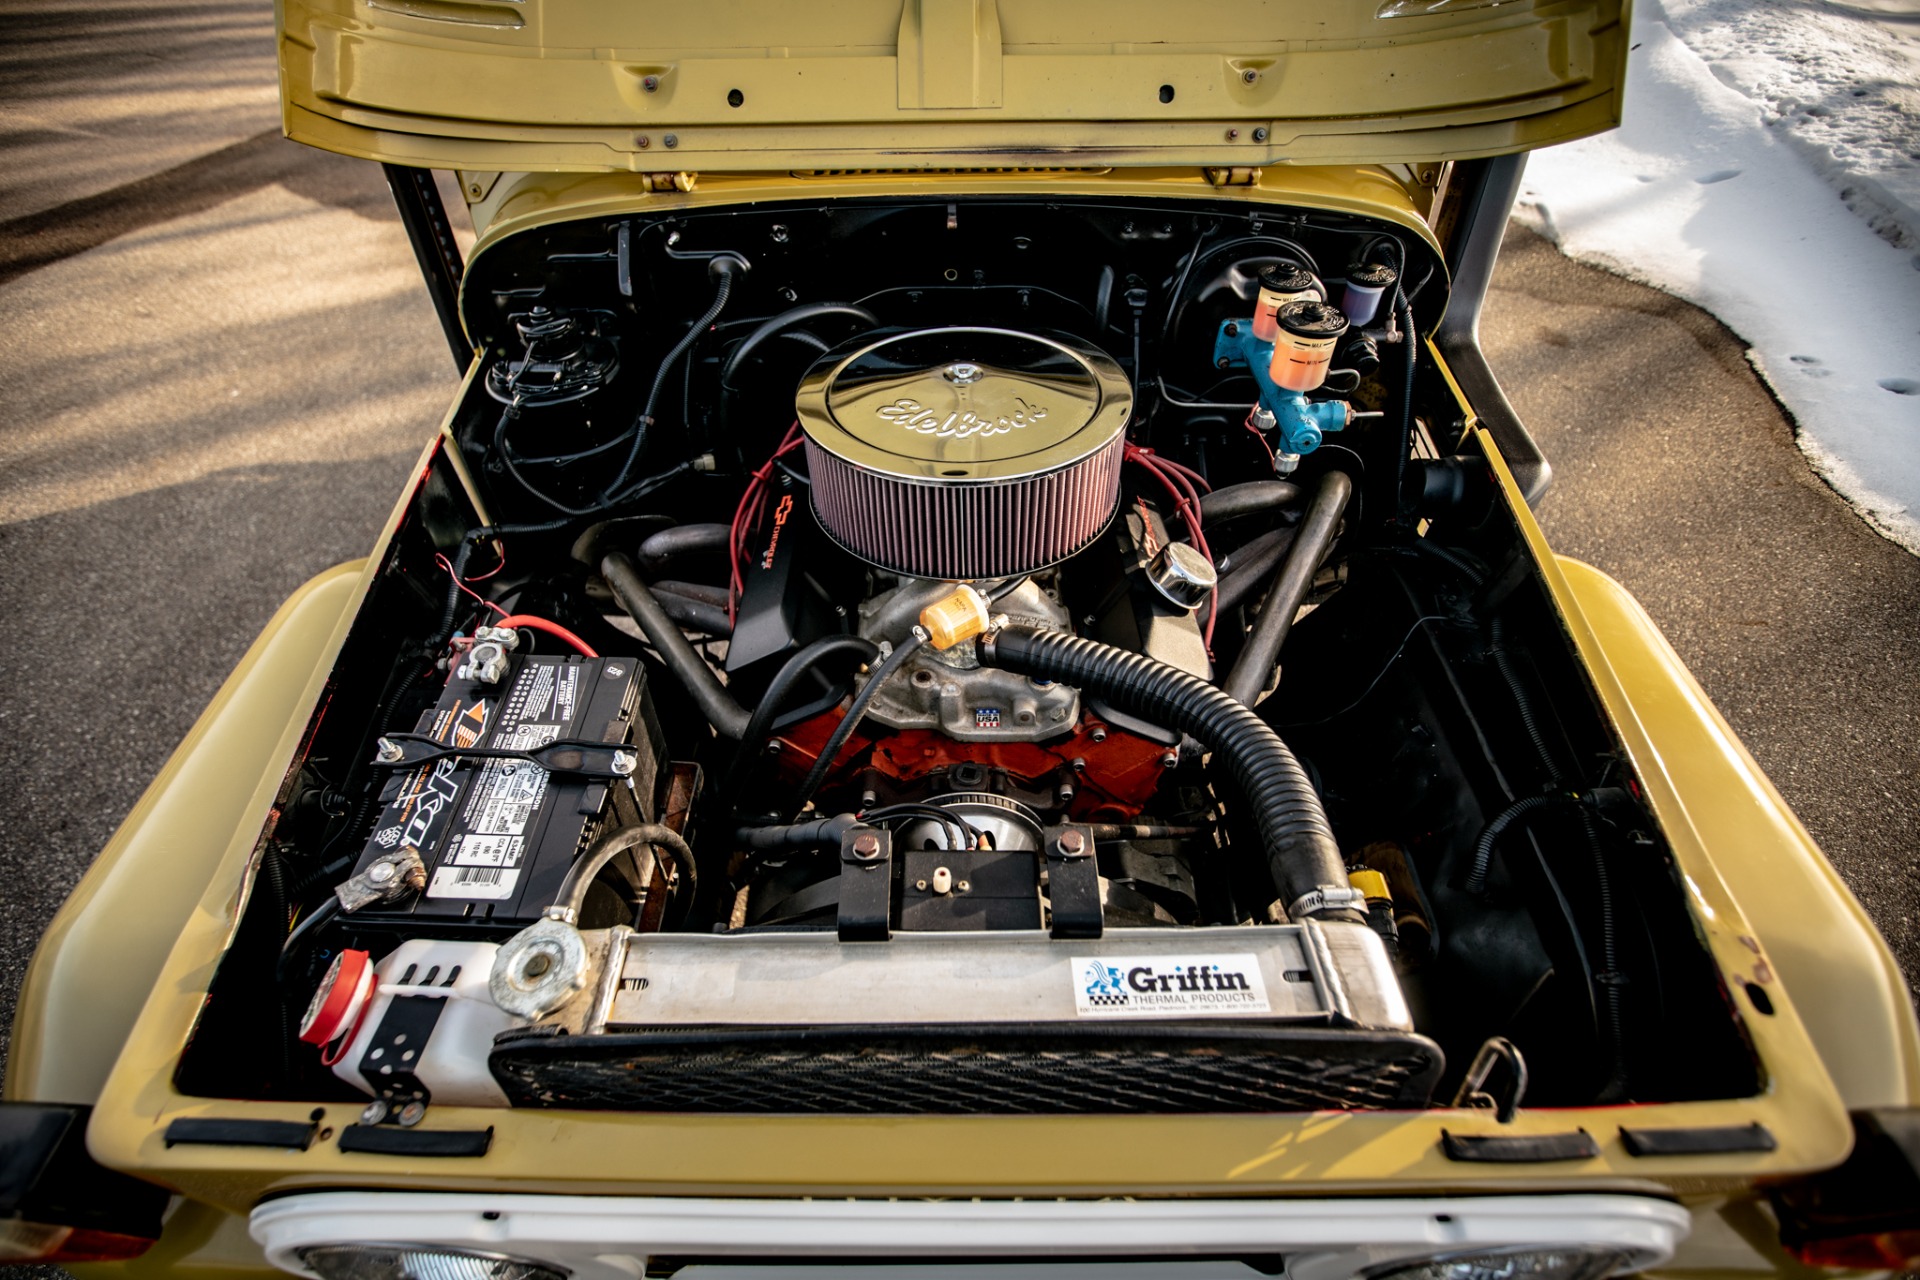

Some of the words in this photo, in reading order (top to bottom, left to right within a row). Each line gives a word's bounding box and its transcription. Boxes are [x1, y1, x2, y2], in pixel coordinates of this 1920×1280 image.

[876, 397, 1049, 438] Edelbrock
[558, 680, 567, 705] BATTERY
[562, 666, 576, 721] MAINTENANCE-FREE
[532, 770, 551, 810] ER/POISON
[473, 842, 482, 850] 110
[497, 838, 506, 848] CCA
[508, 840, 519, 860] 634MF
[1128, 965, 1250, 992] Griffin
[1132, 994, 1188, 1004] THERMAL
[1191, 992, 1256, 1003] PRODUCTS
